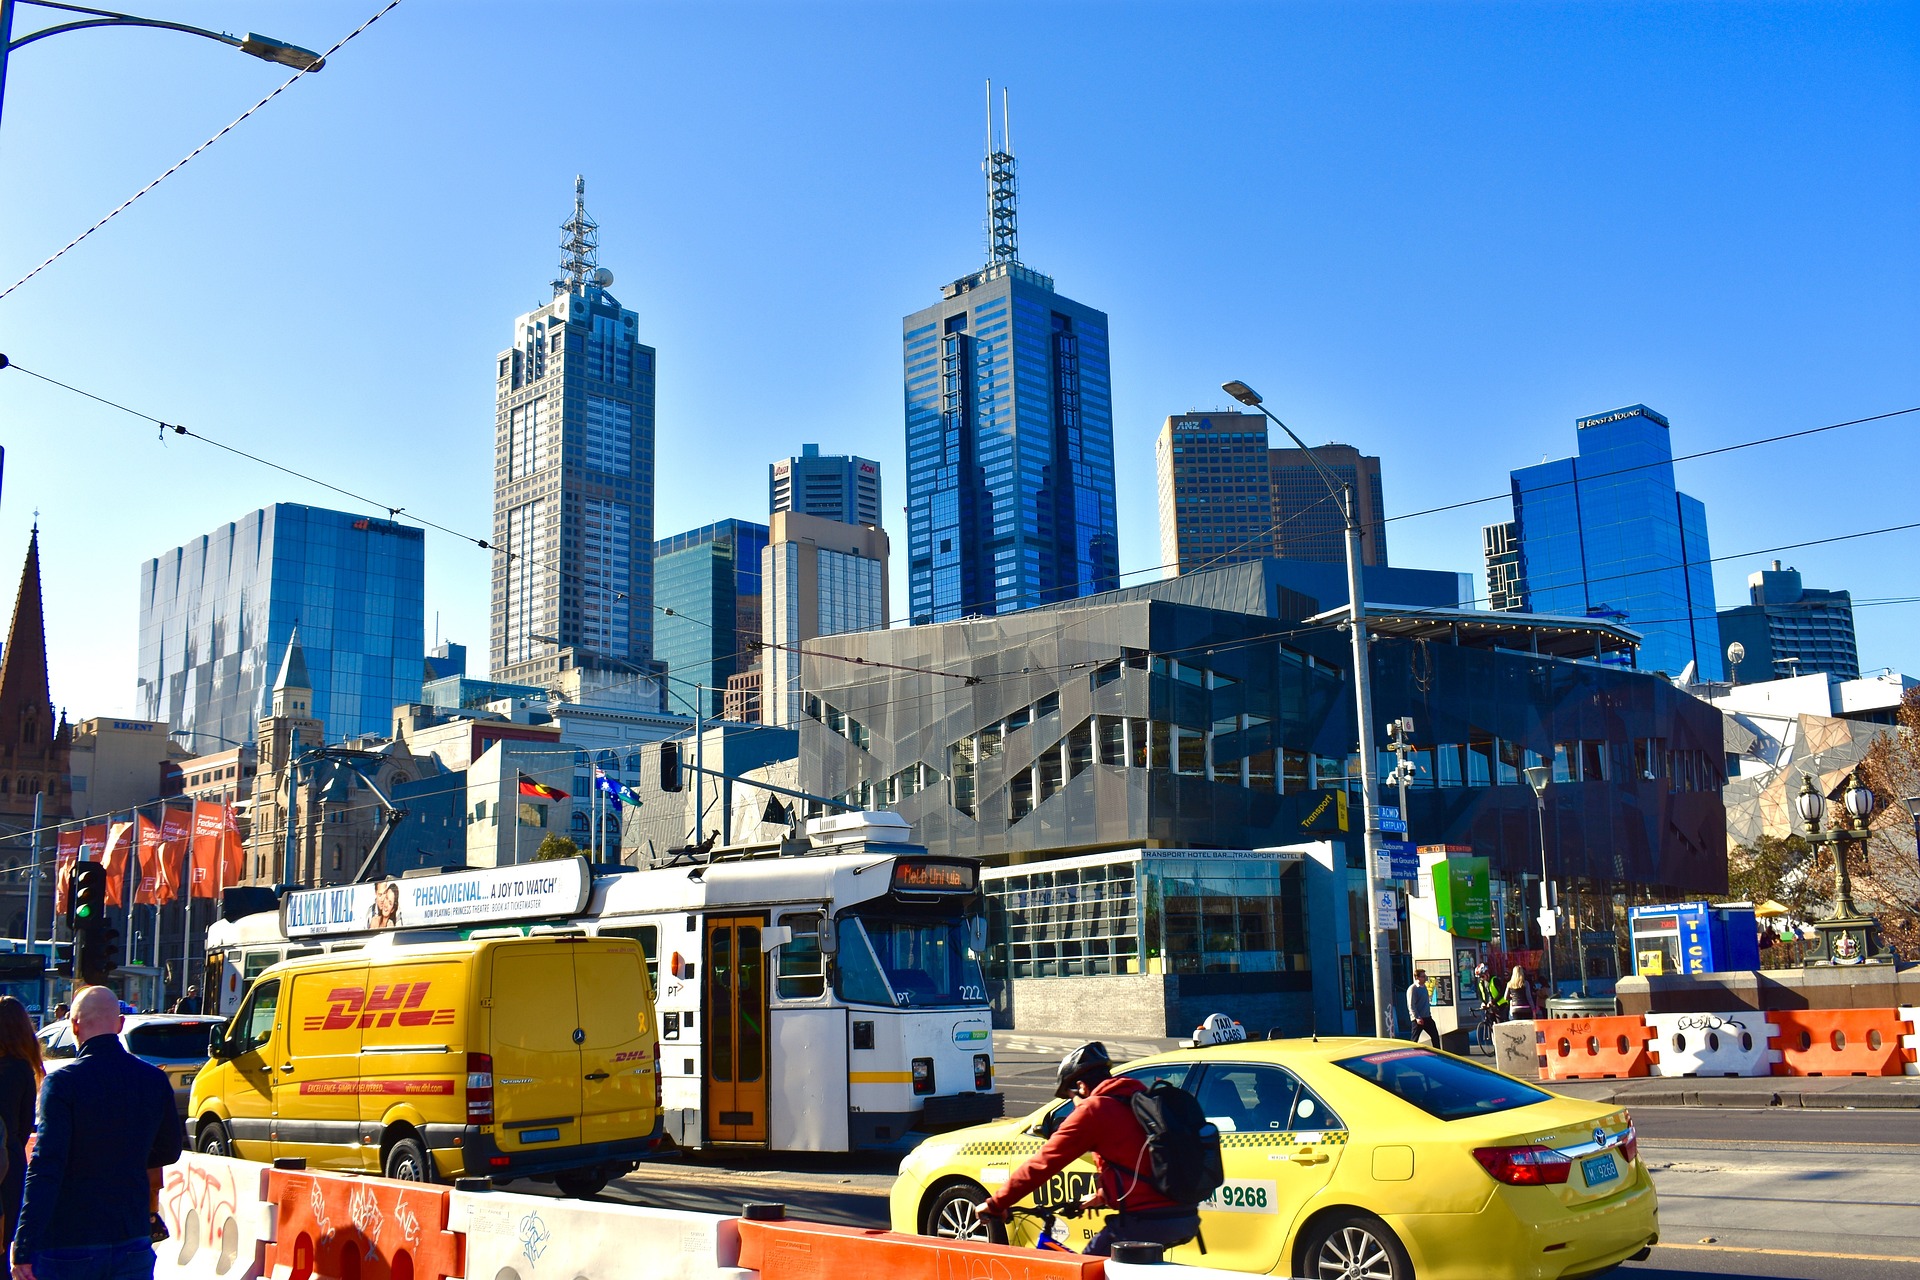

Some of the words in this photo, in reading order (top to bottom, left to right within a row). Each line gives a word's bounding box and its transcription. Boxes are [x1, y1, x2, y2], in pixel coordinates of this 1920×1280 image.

[1176, 421, 1200, 430] ANZ
[114, 721, 153, 731] REGENT
[1301, 794, 1333, 827] Transport
[1381, 807, 1396, 818] ACMI
[1382, 820, 1402, 831] ARTPLAY
[904, 867, 927, 884] Melb
[929, 868, 945, 885] Uni
[490, 884, 496, 899] A
[497, 882, 512, 898] JOY
[514, 880, 524, 896] TO
[288, 892, 326, 927] MAMMA
[329, 888, 354, 923] MIA!
[424, 910, 434, 918] NOW
[434, 908, 450, 917] PLAYING
[452, 905, 471, 915] PRINCESS
[472, 904, 489, 913] THEATRE
[492, 902, 503, 912] BOOK
[510, 899, 541, 910] TICKETMASTER
[1640, 905, 1665, 913] Melbourne
[959, 985, 983, 1000] 222
[322, 982, 435, 1030] DHL
[1215, 1018, 1232, 1030] TAXI
[1212, 1031, 1221, 1044] 13
[1223, 1029, 1241, 1042] CABS
[615, 1051, 646, 1062] DHL
[338, 1084, 356, 1093] SIMPLY
[404, 1084, 443, 1093] www.dhl.com
[1599, 1162, 1616, 1178] 9268
[1222, 1185, 1268, 1208] 9268
